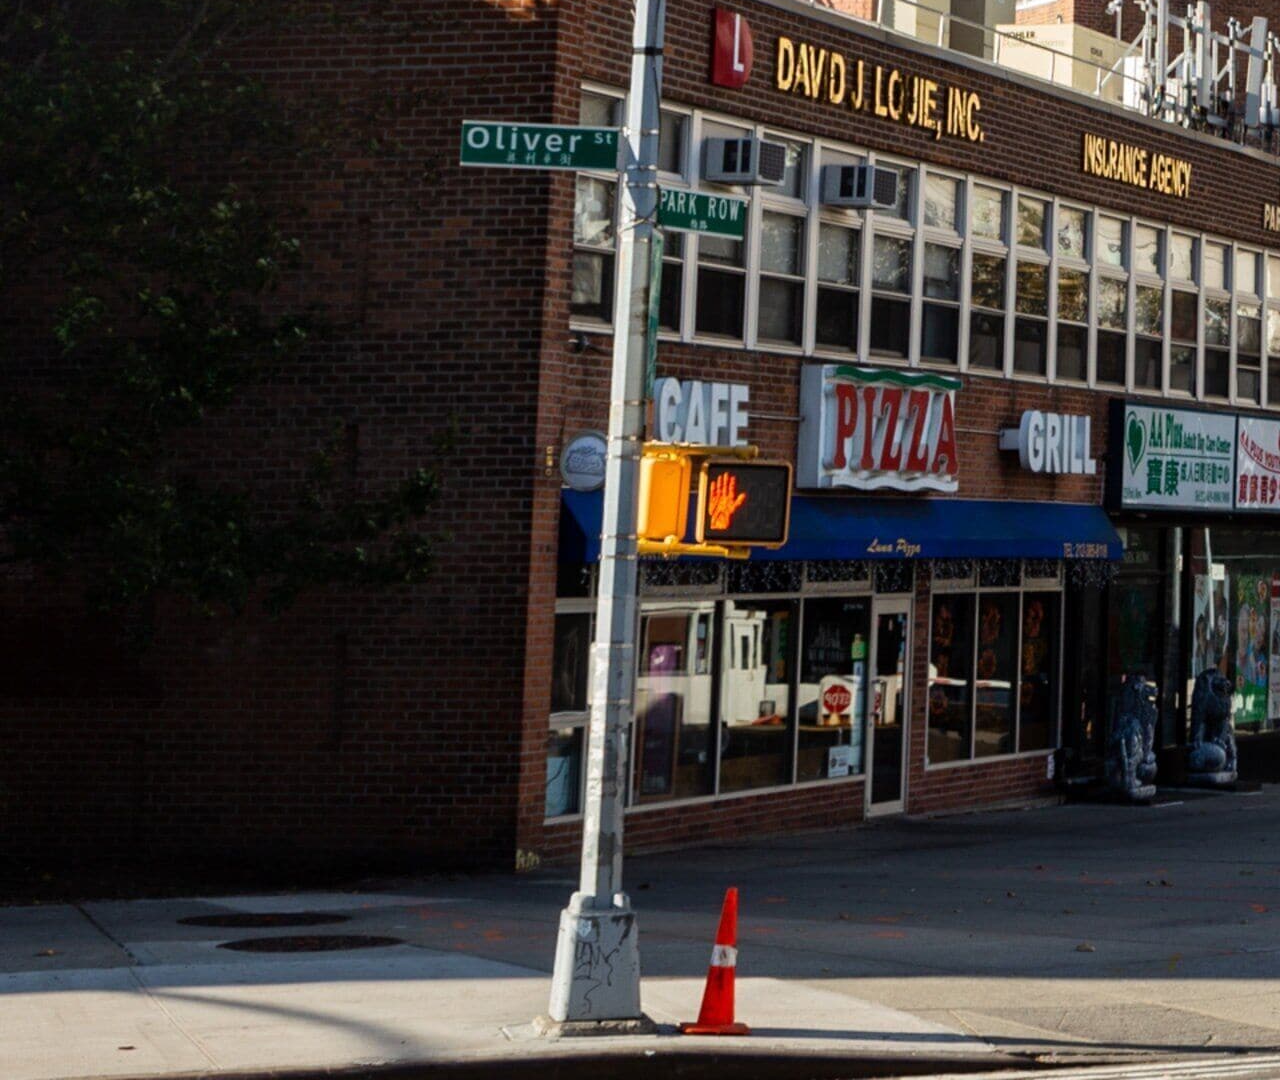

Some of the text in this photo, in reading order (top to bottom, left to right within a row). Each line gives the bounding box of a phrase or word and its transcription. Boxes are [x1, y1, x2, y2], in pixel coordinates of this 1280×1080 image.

[946, 86, 985, 143] INC.
[467, 126, 613, 153] Oliver St
[1149, 151, 1192, 199] AGENCY
[661, 190, 740, 222] PARK ROW
[658, 377, 749, 446] CAFE
[833, 383, 959, 475] PIZZA
[1148, 411, 1164, 449] AA
[1165, 413, 1183, 449] Plus
[1027, 410, 1097, 474] GRILL
[896, 538, 921, 558] Pizza
